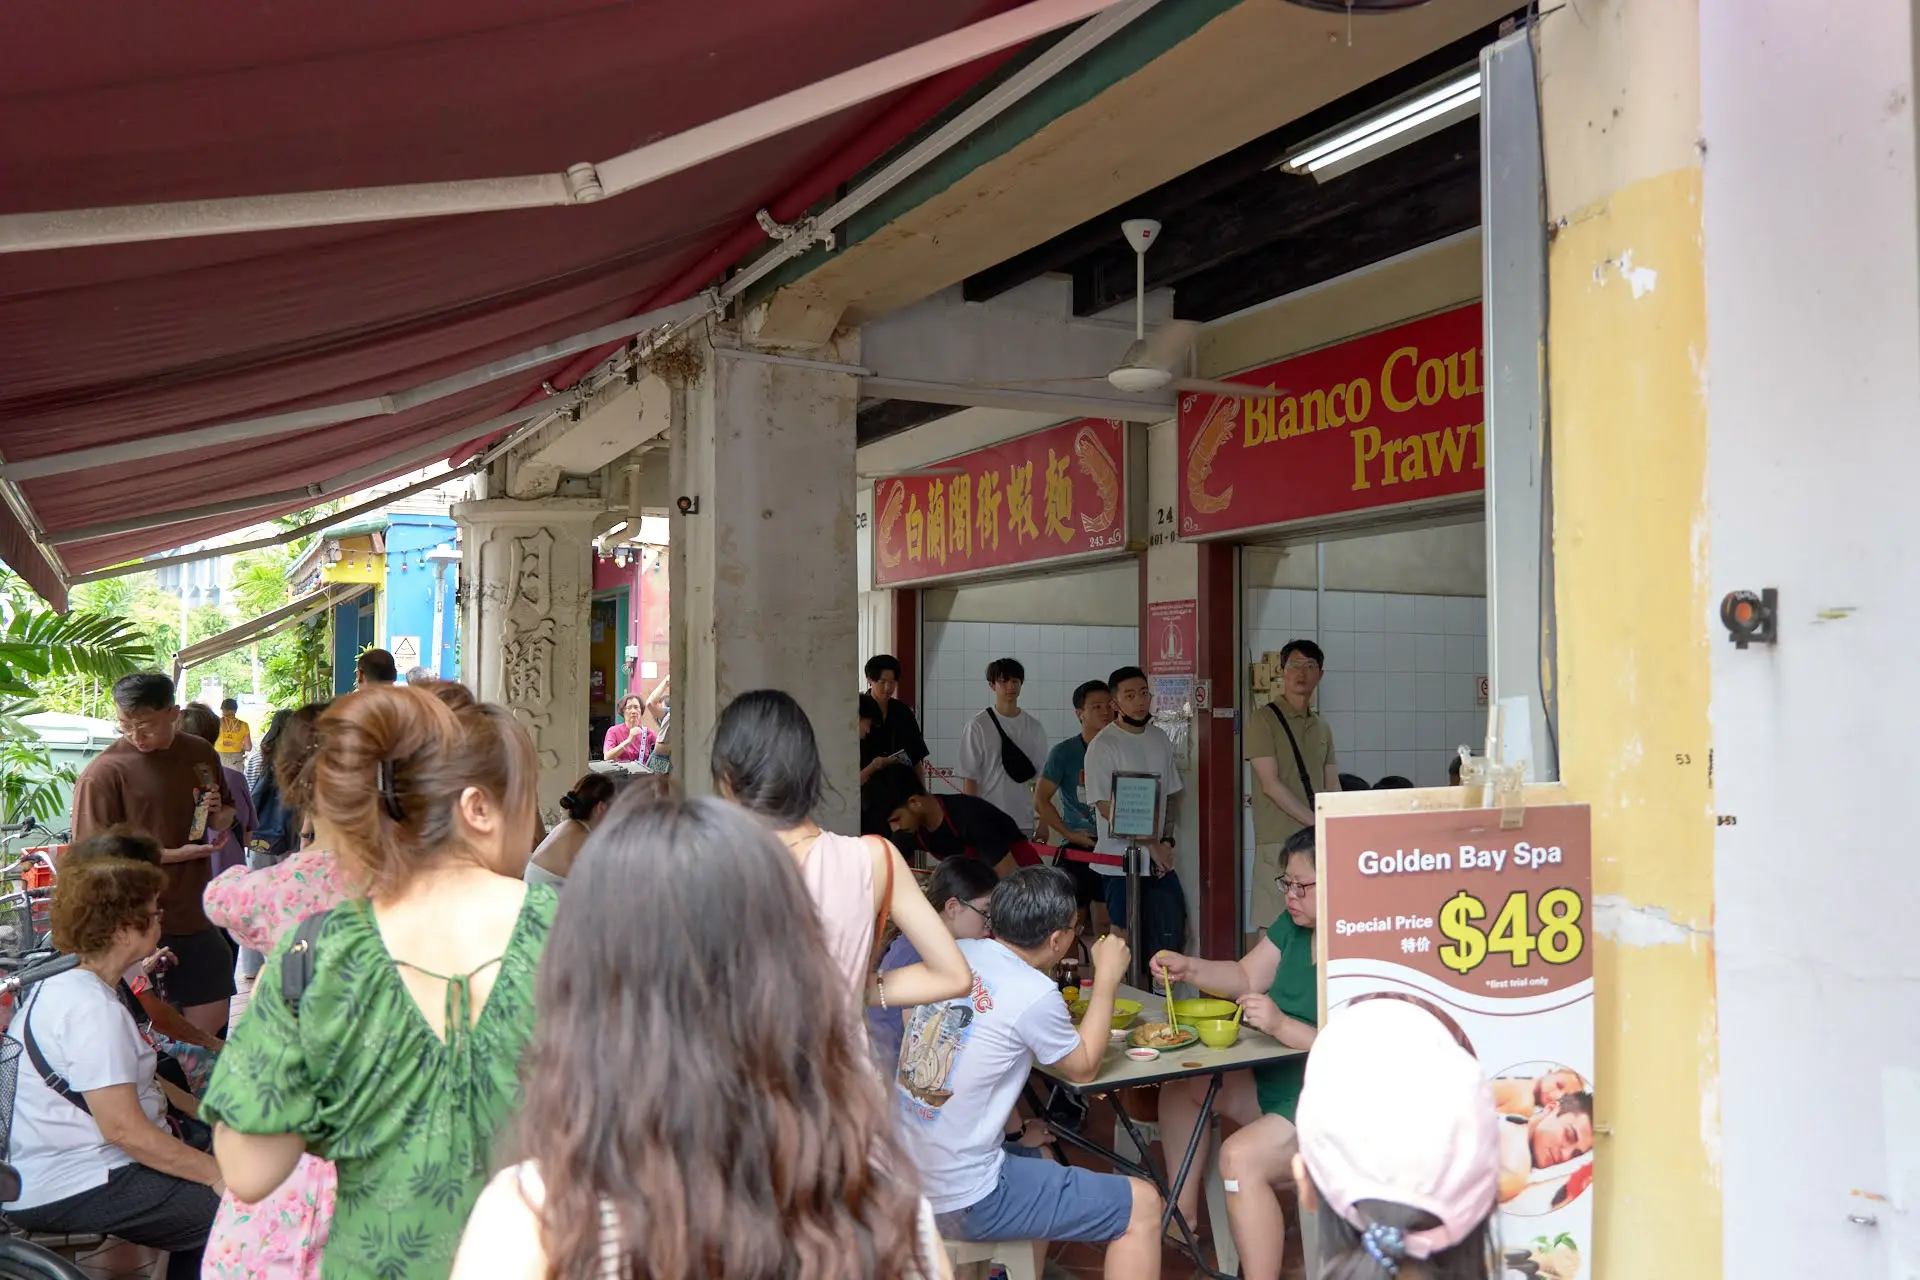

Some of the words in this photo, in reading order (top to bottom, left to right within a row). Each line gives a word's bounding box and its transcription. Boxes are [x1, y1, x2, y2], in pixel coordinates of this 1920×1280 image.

[1242, 377, 1372, 448] Blanco
[1380, 346, 1483, 413] Cou
[1357, 848, 1451, 875] Golden
[1459, 845, 1507, 871] Bay
[1513, 841, 1562, 869] Spa
[1335, 917, 1392, 937] Special
[1395, 914, 1433, 930] Price
[1438, 886, 1585, 975] $48
[1401, 935, 1431, 954] 特价
[1510, 977, 1528, 988] trial
[1529, 976, 1550, 987] only
